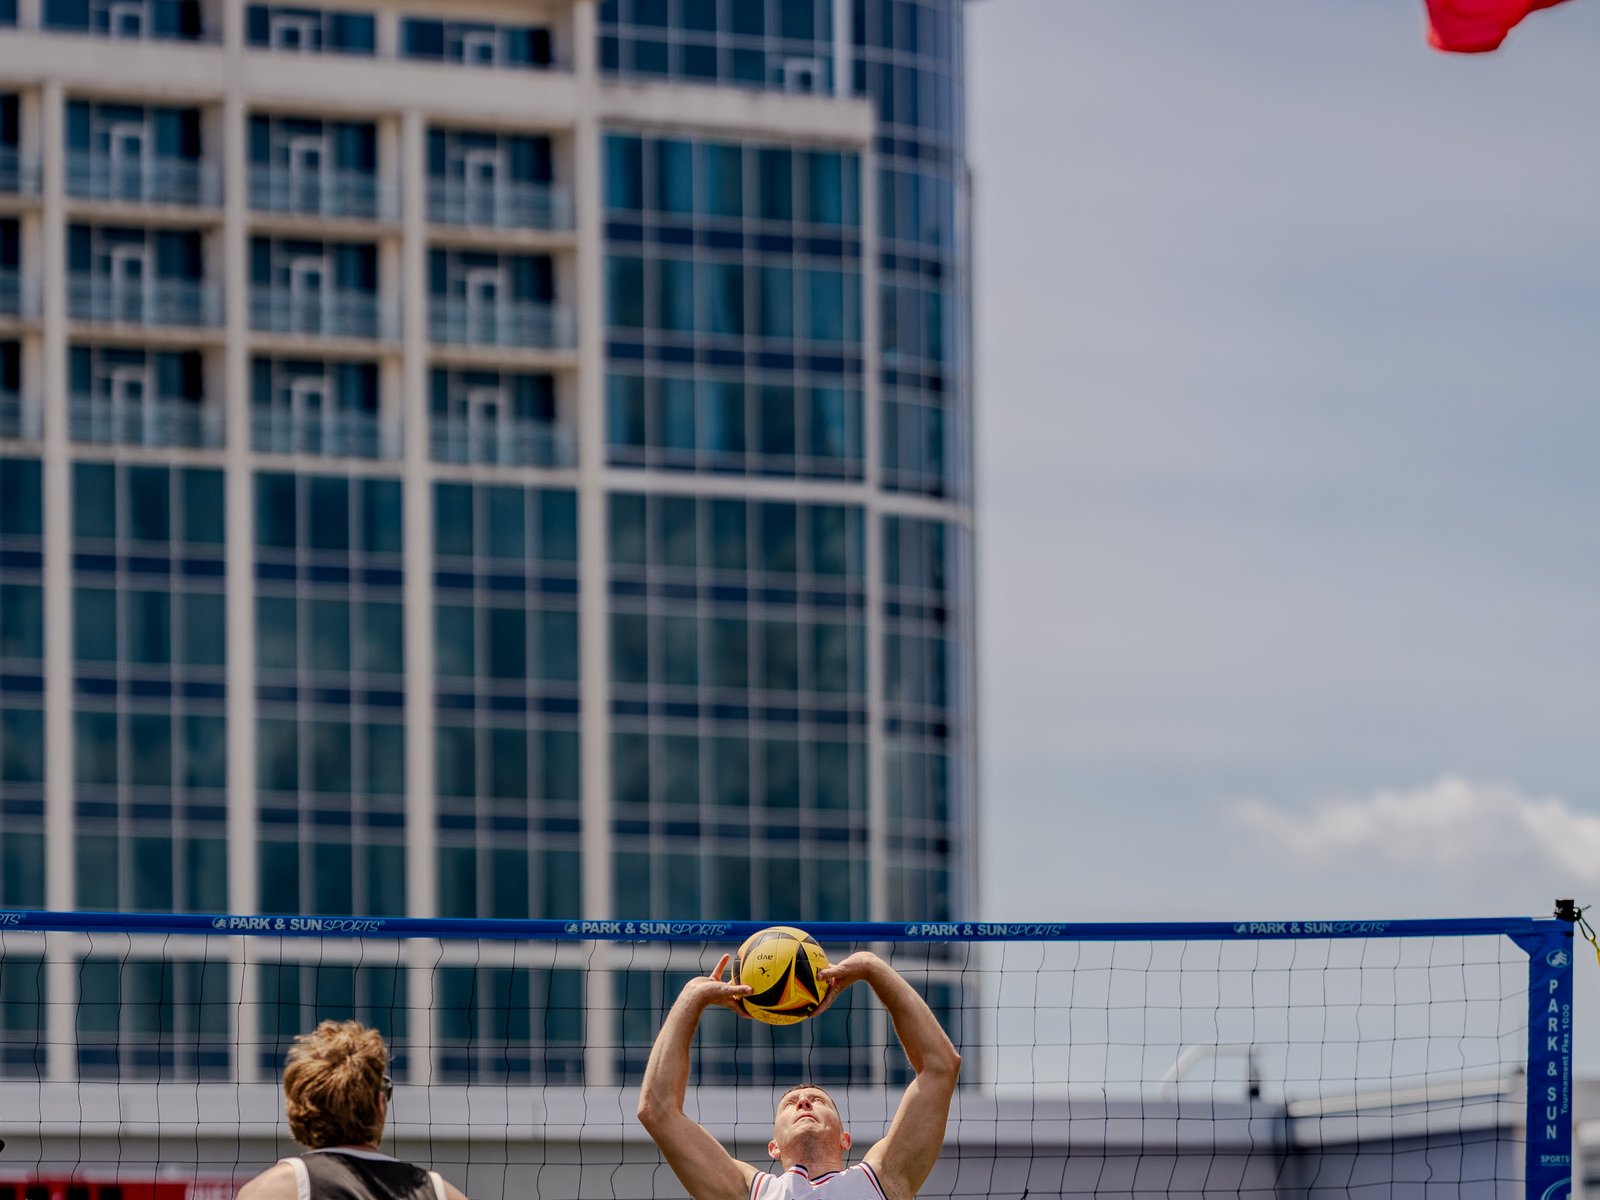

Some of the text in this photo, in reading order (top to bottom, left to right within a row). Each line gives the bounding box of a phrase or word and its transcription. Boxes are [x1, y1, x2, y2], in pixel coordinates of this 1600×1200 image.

[229, 917, 271, 930] PARK
[274, 918, 286, 930] &
[581, 922, 621, 934] PARK
[625, 922, 636, 934] &
[1250, 922, 1287, 934] PARK
[1290, 922, 1301, 934] &
[921, 924, 959, 936] PARK
[962, 924, 974, 936] &
[1545, 979, 1559, 1141] PARK & SUN
[1561, 1056, 1569, 1115] Tournament
